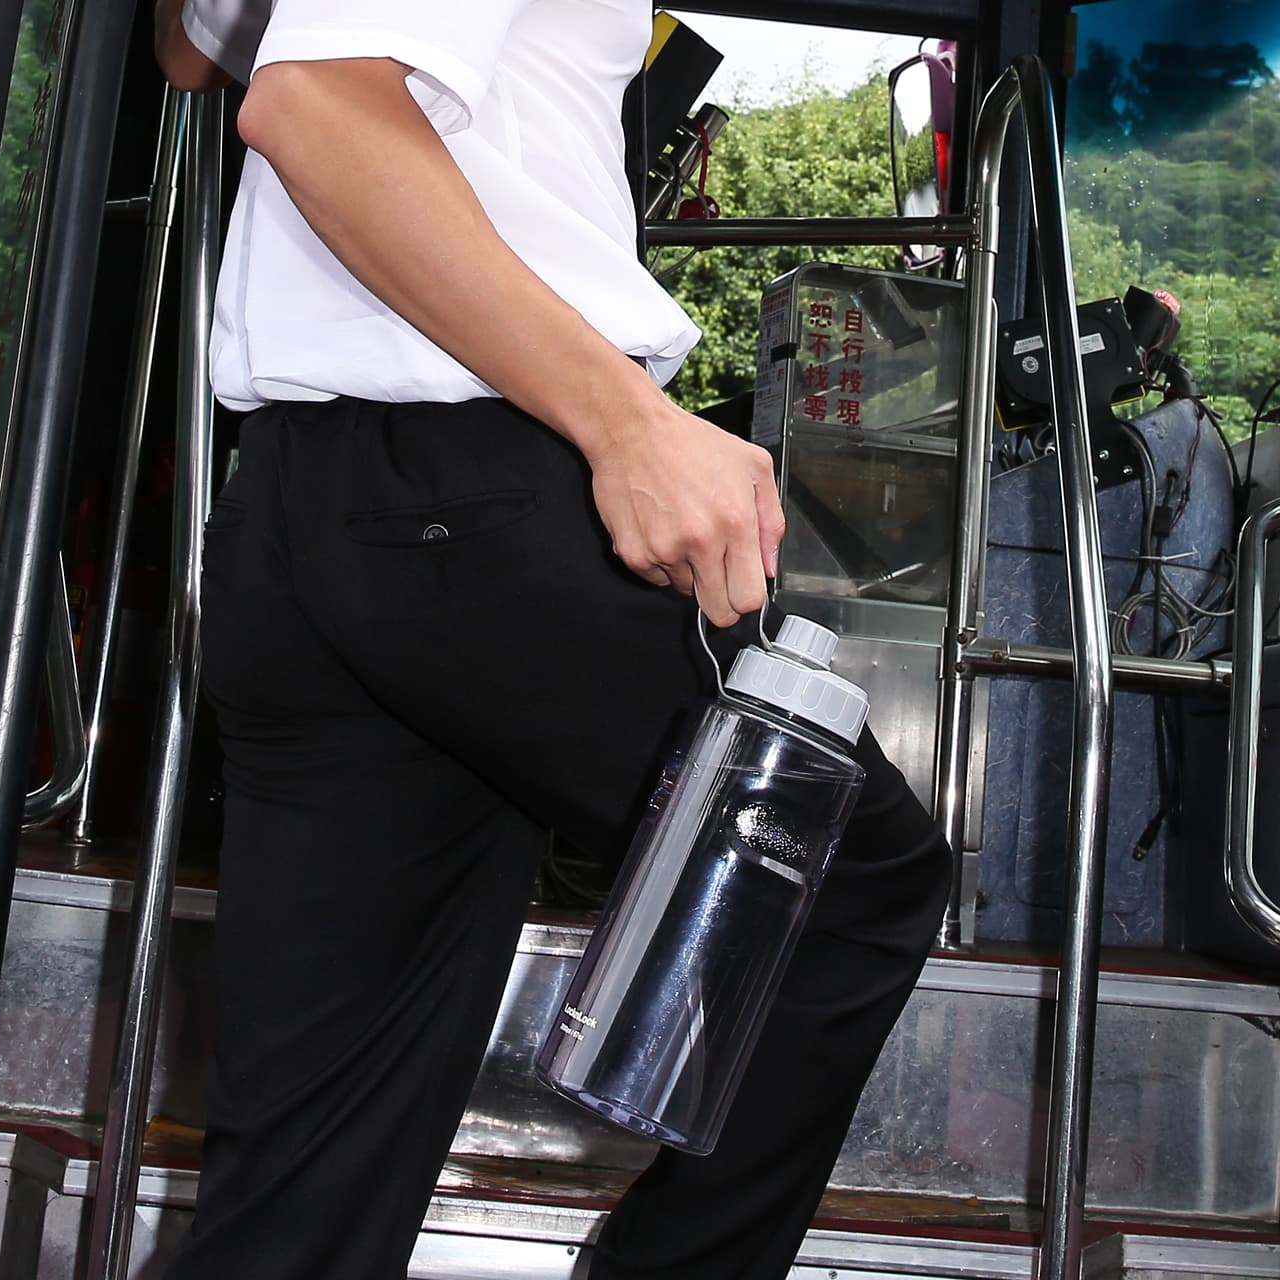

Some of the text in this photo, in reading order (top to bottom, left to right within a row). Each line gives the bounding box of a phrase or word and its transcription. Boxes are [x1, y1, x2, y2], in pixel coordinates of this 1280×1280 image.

[804, 303, 833, 422] 恕不找零
[837, 308, 865, 426] 自行投現
